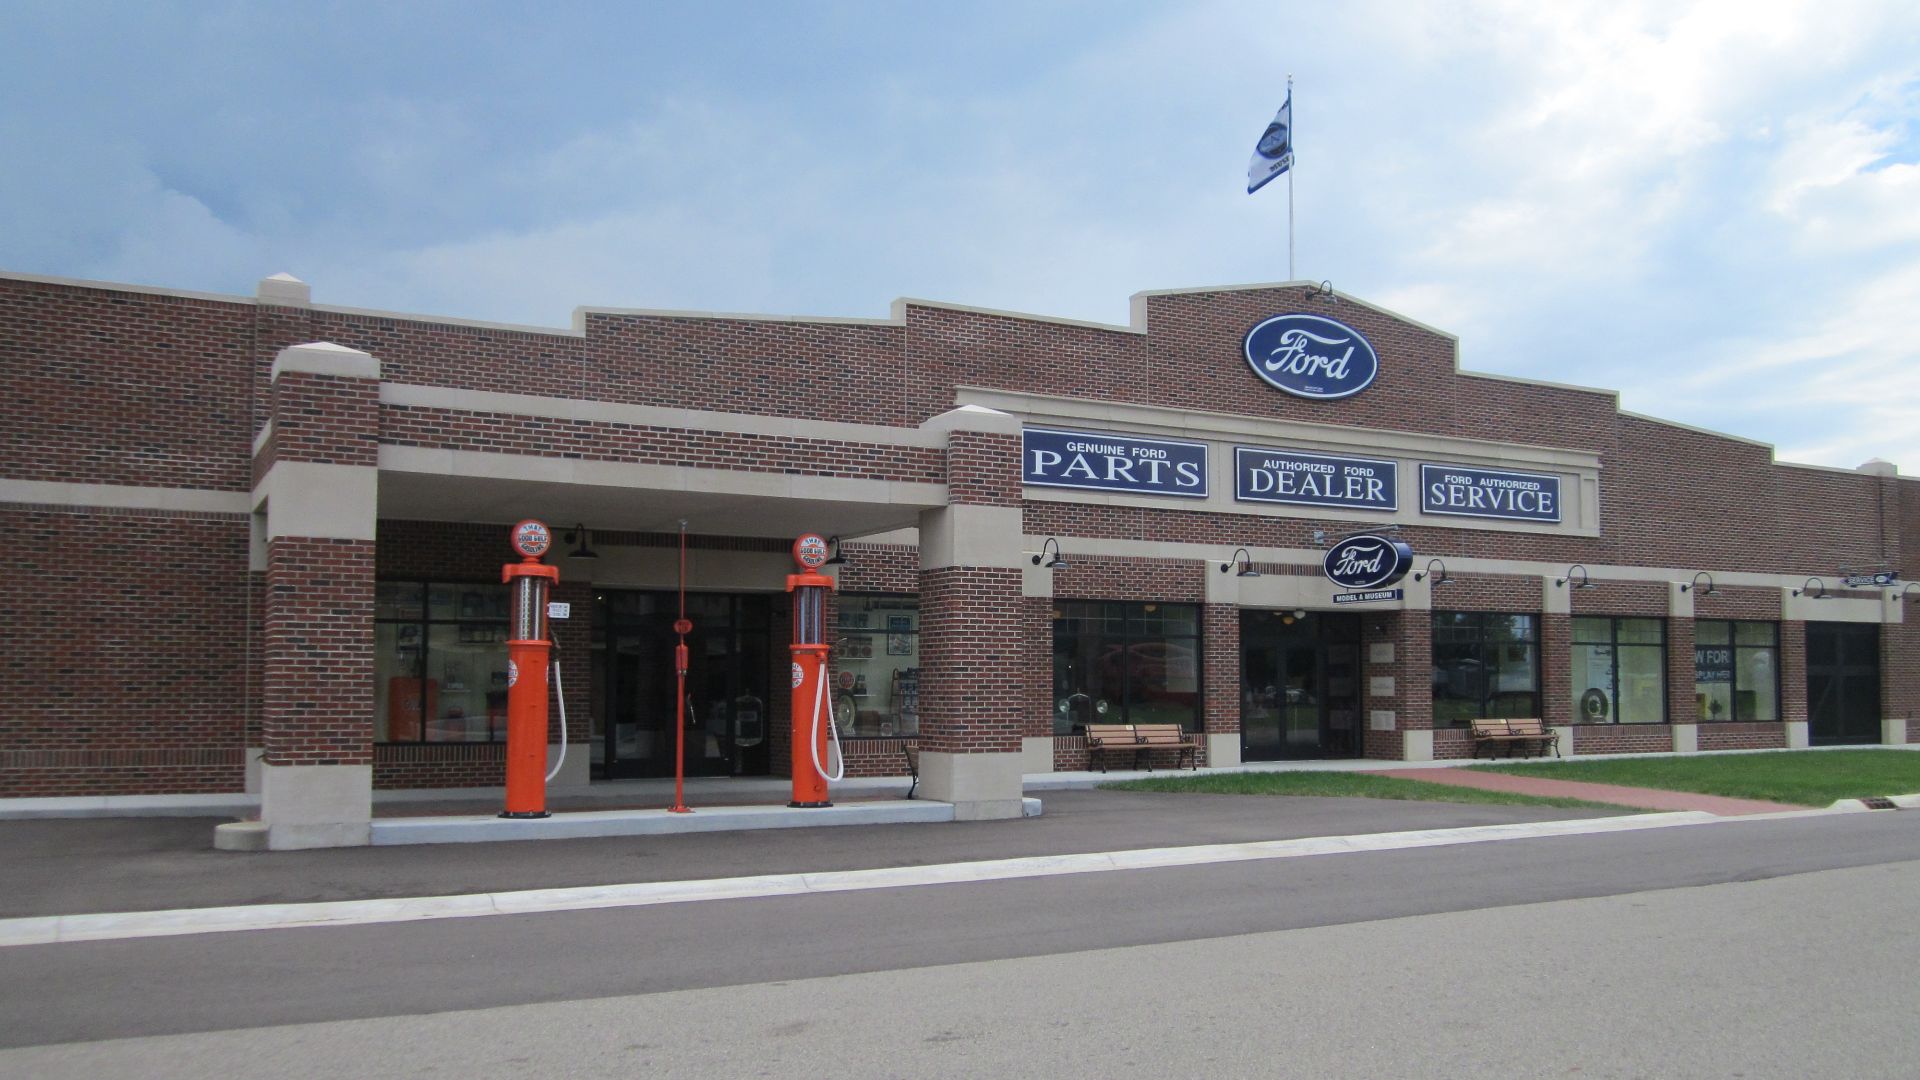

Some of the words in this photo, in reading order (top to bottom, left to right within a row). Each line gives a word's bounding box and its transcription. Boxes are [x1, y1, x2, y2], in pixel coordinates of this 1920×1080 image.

[1265, 329, 1355, 380] Ford
[1066, 441, 1125, 456] GENUINE
[1132, 447, 1167, 459] FORD
[1030, 449, 1201, 487] PARTS
[1263, 459, 1336, 474] AUTHORIZED
[1344, 466, 1375, 477] FORD
[1250, 467, 1387, 502] DEALER
[1444, 474, 1473, 485] FORD
[1480, 478, 1540, 491] AUTHORIZED
[1431, 482, 1554, 513] SERVICE
[523, 524, 543, 532] THAT
[1333, 544, 1385, 576] Ford
[1848, 576, 1874, 585] SERVICE
[1336, 594, 1358, 602] MODEL
[1364, 591, 1393, 600] MUSEUM
